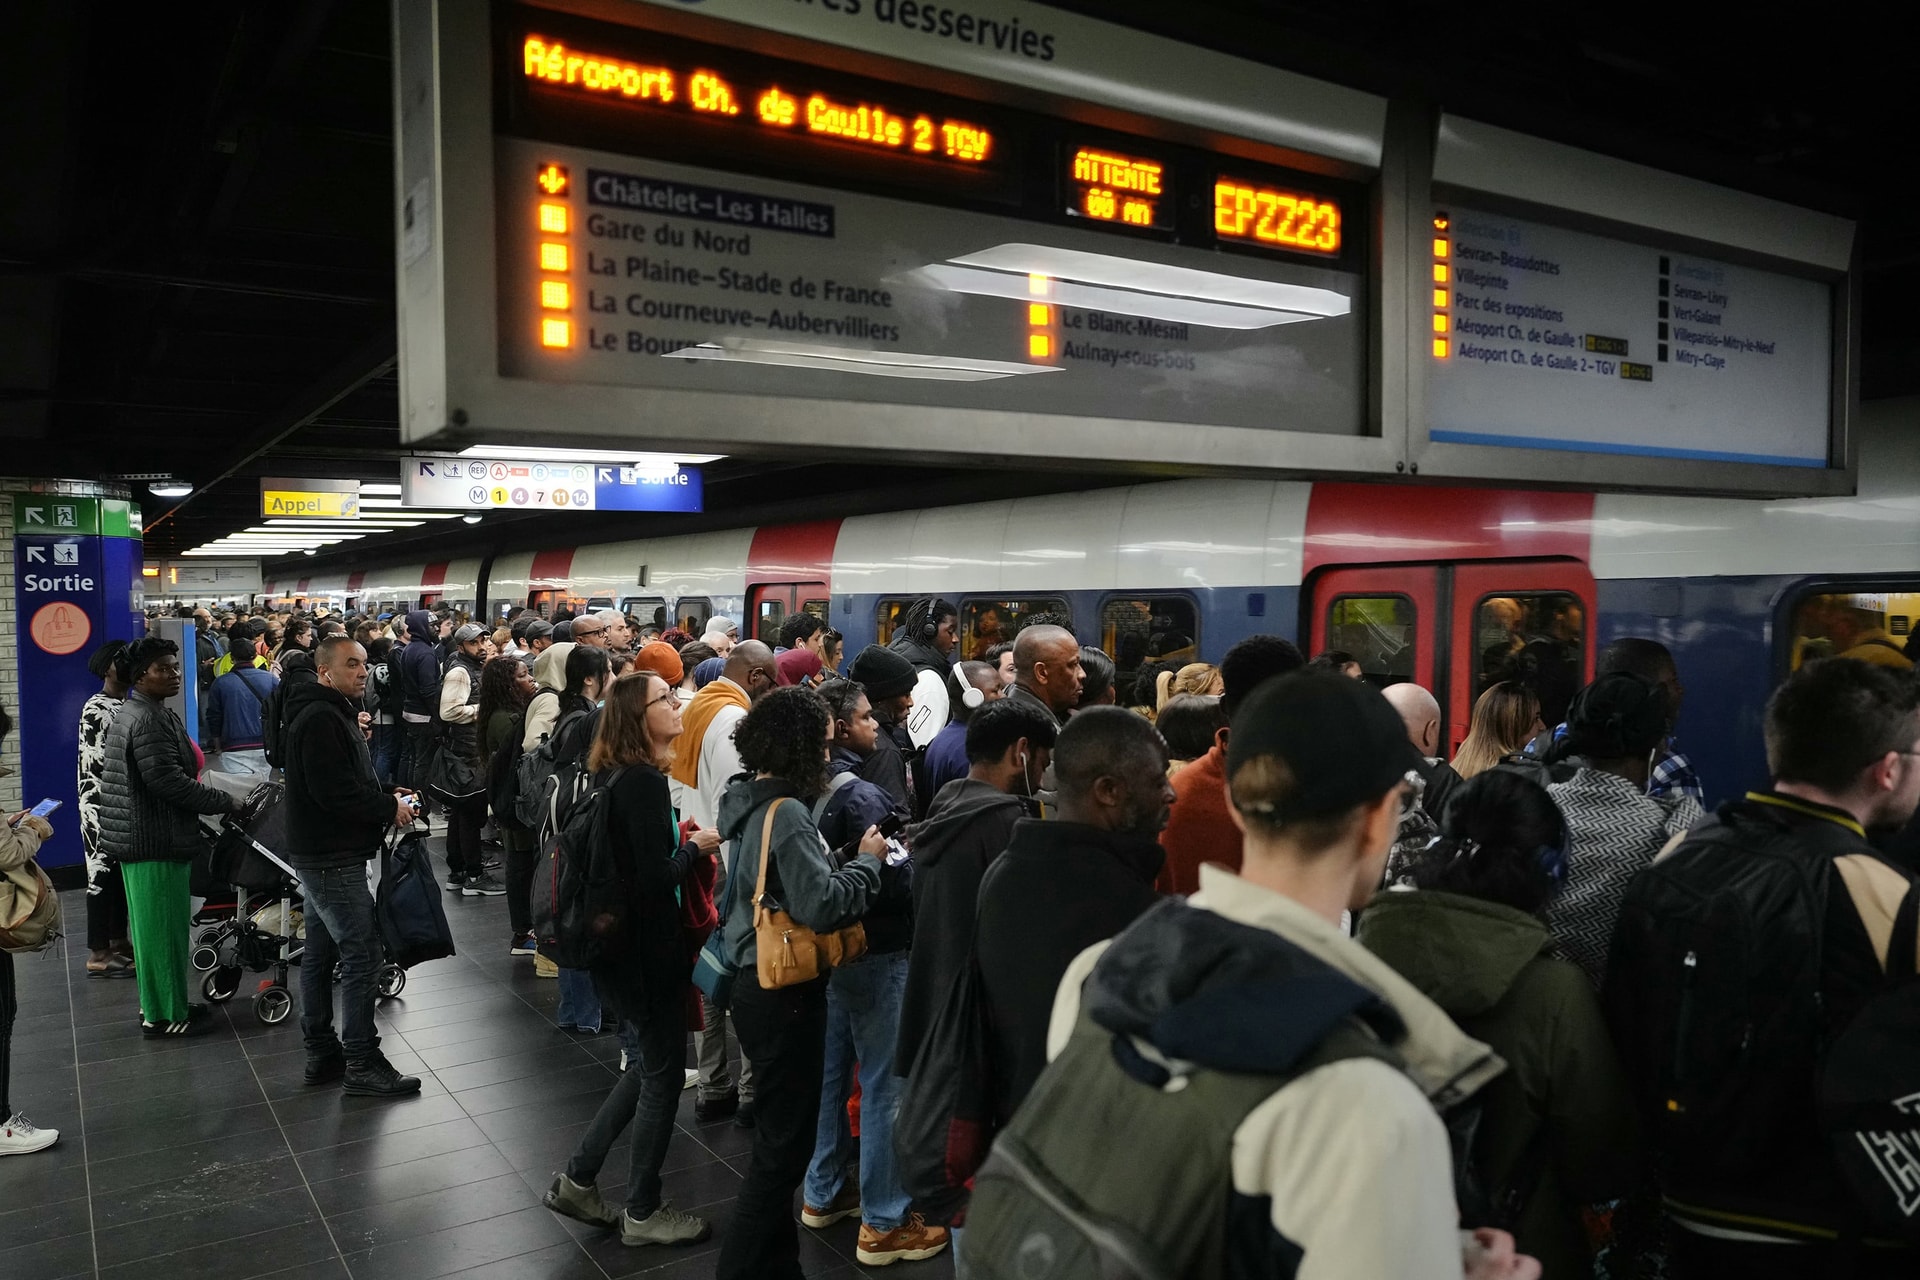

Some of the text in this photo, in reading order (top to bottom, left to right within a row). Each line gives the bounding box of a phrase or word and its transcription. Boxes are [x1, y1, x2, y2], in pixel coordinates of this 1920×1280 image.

[524, 38, 988, 161] Aéroport Ch. de Gaulle 2 TGV
[1074, 151, 1161, 194] ATTENTE
[760, 201, 829, 232] Halles
[587, 213, 751, 256] Gare du Nord
[588, 251, 893, 308] La Plaine-Stade de France
[1456, 267, 1509, 290] Villepinte
[588, 289, 899, 342] La Courneuve-Aubervilliers
[1456, 292, 1563, 323] Parc des expositions
[588, 328, 618, 352] Le
[1062, 309, 1188, 341] Le Blanc-Mesnil
[1456, 317, 1583, 349] Aéroport Ch. de Gaulle 1
[1458, 341, 1507, 364] Aéroport
[1511, 349, 1528, 365] Ch.
[1530, 351, 1544, 367] de
[1546, 353, 1577, 371] Gaulle
[470, 466, 485, 475] RER
[271, 497, 321, 514] Appel
[515, 491, 525, 501] 4
[537, 491, 545, 502] 7
[555, 492, 567, 503] 11
[574, 493, 588, 504] 14
[24, 573, 94, 592] Sortie
